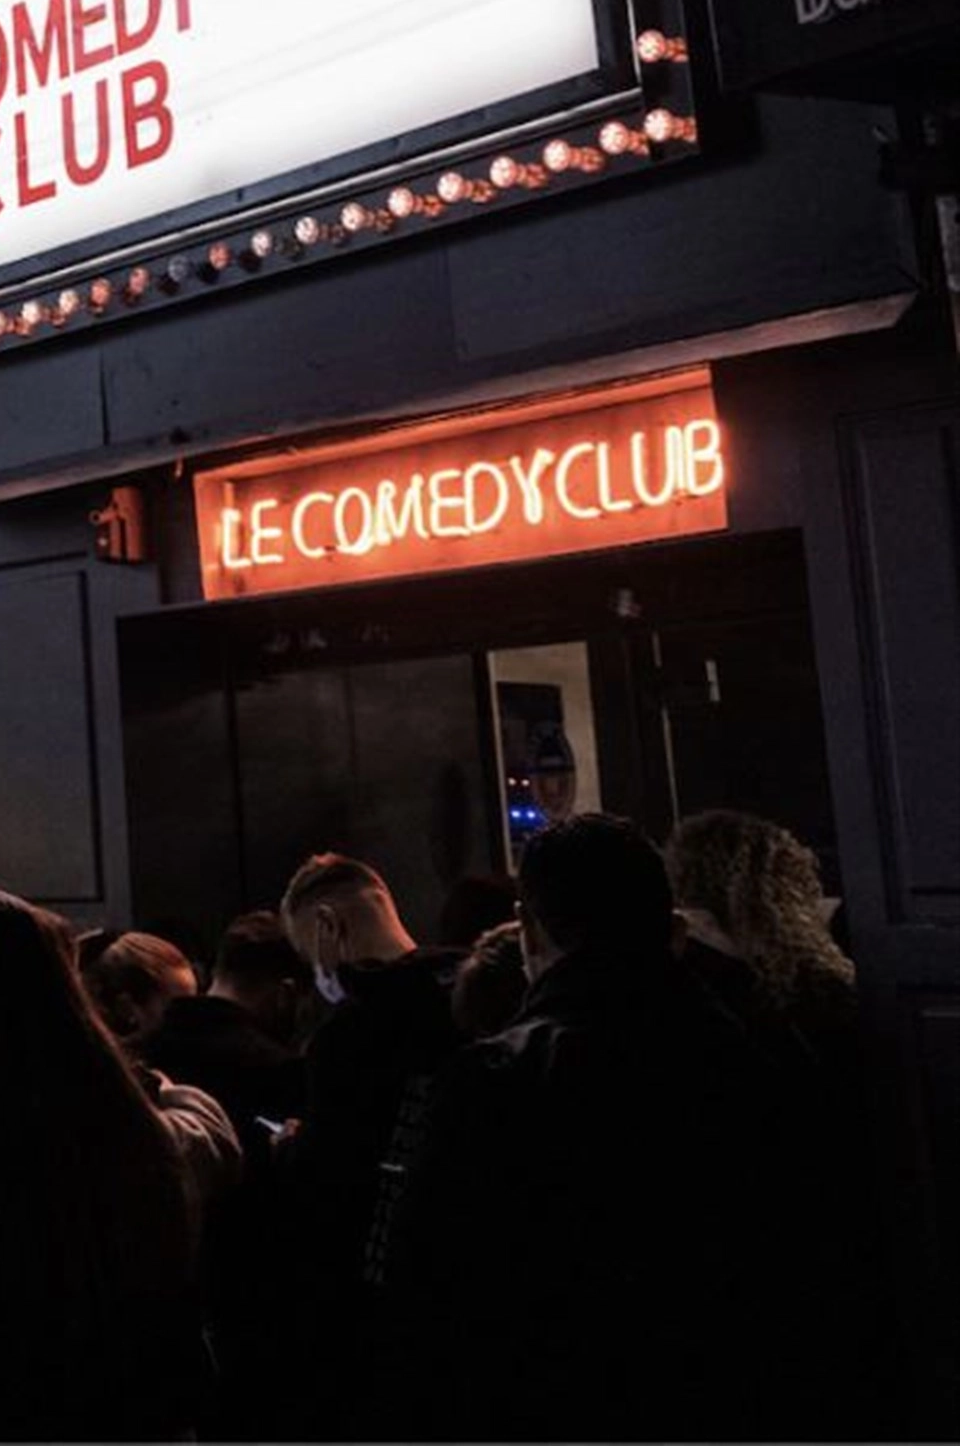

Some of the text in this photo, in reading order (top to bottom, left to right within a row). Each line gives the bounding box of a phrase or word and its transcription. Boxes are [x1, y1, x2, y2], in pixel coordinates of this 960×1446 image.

[220, 418, 725, 569] LE COMEDY CLUB
